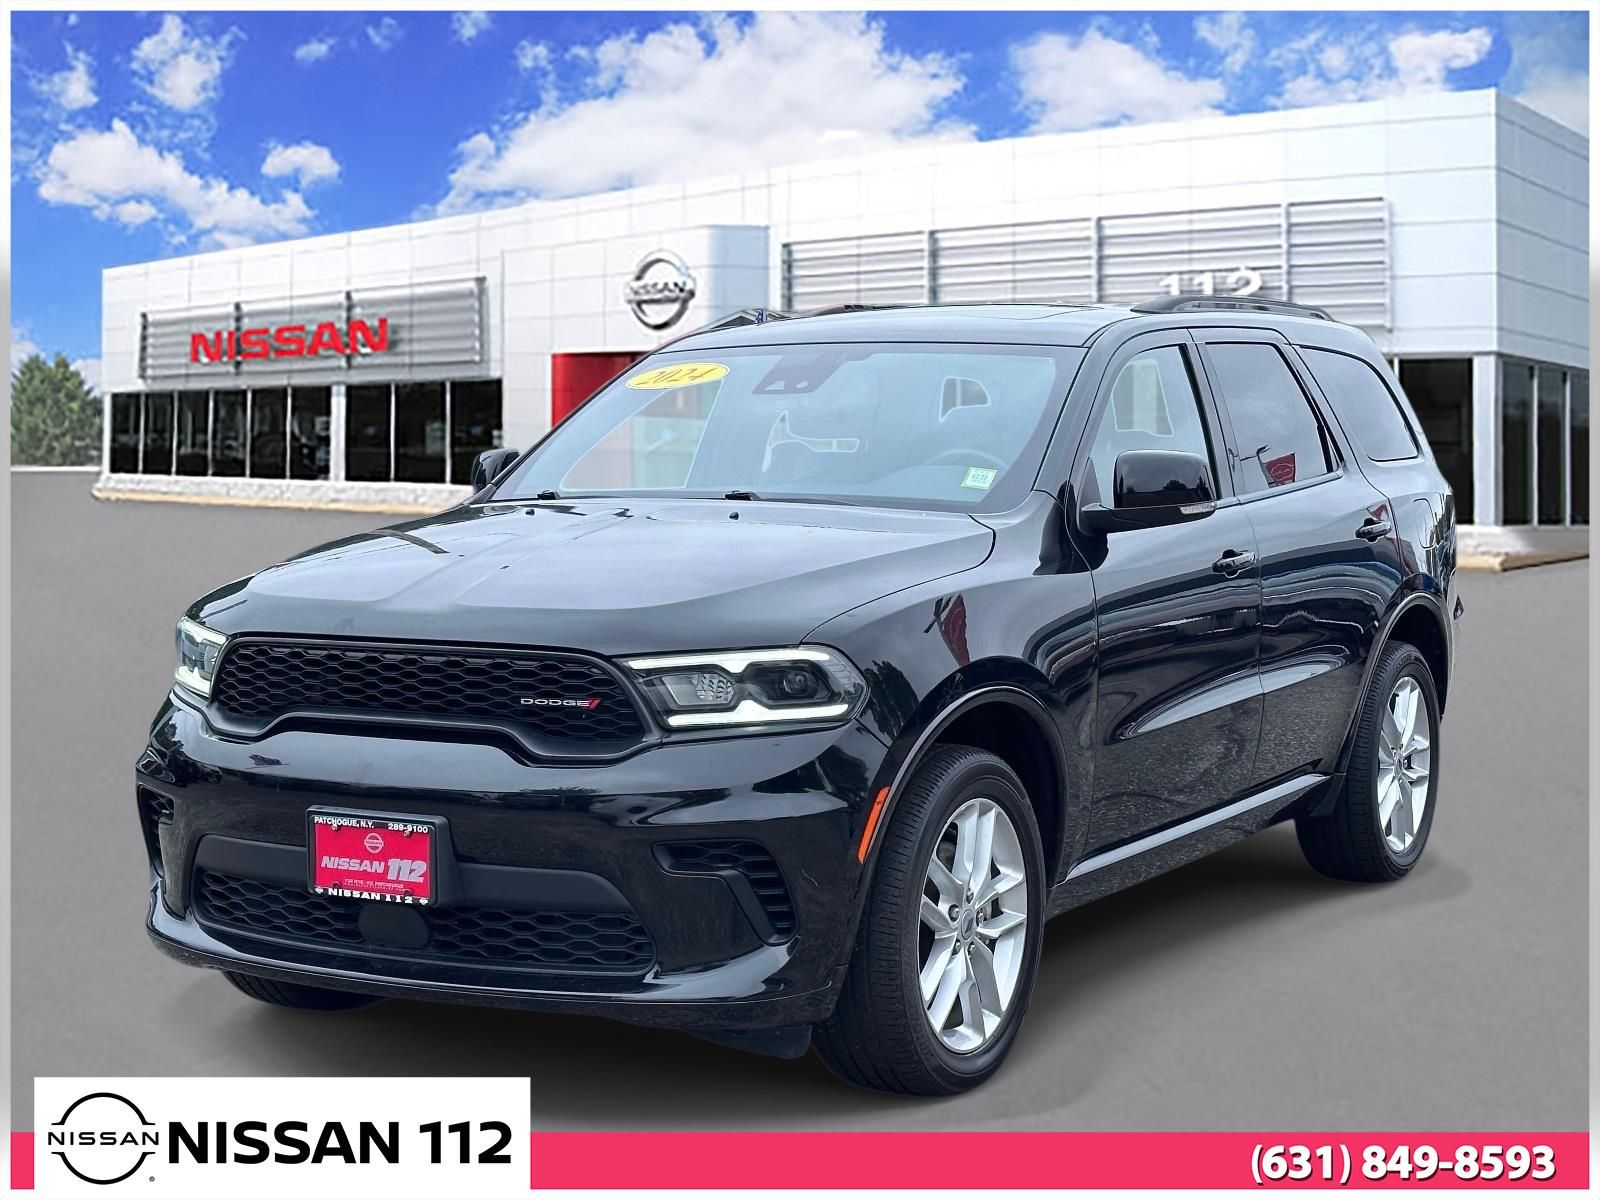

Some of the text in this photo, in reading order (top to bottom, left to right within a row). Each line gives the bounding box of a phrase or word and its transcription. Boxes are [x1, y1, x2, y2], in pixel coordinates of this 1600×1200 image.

[189, 317, 389, 364] NISSAN
[634, 367, 719, 386] 2024
[520, 699, 590, 707] DODGE
[315, 816, 375, 829] PATCHOGUE, N.Y.
[388, 823, 428, 833] 289-9100
[321, 856, 427, 883] NISSAN 112
[328, 888, 412, 904] NISSAN 112
